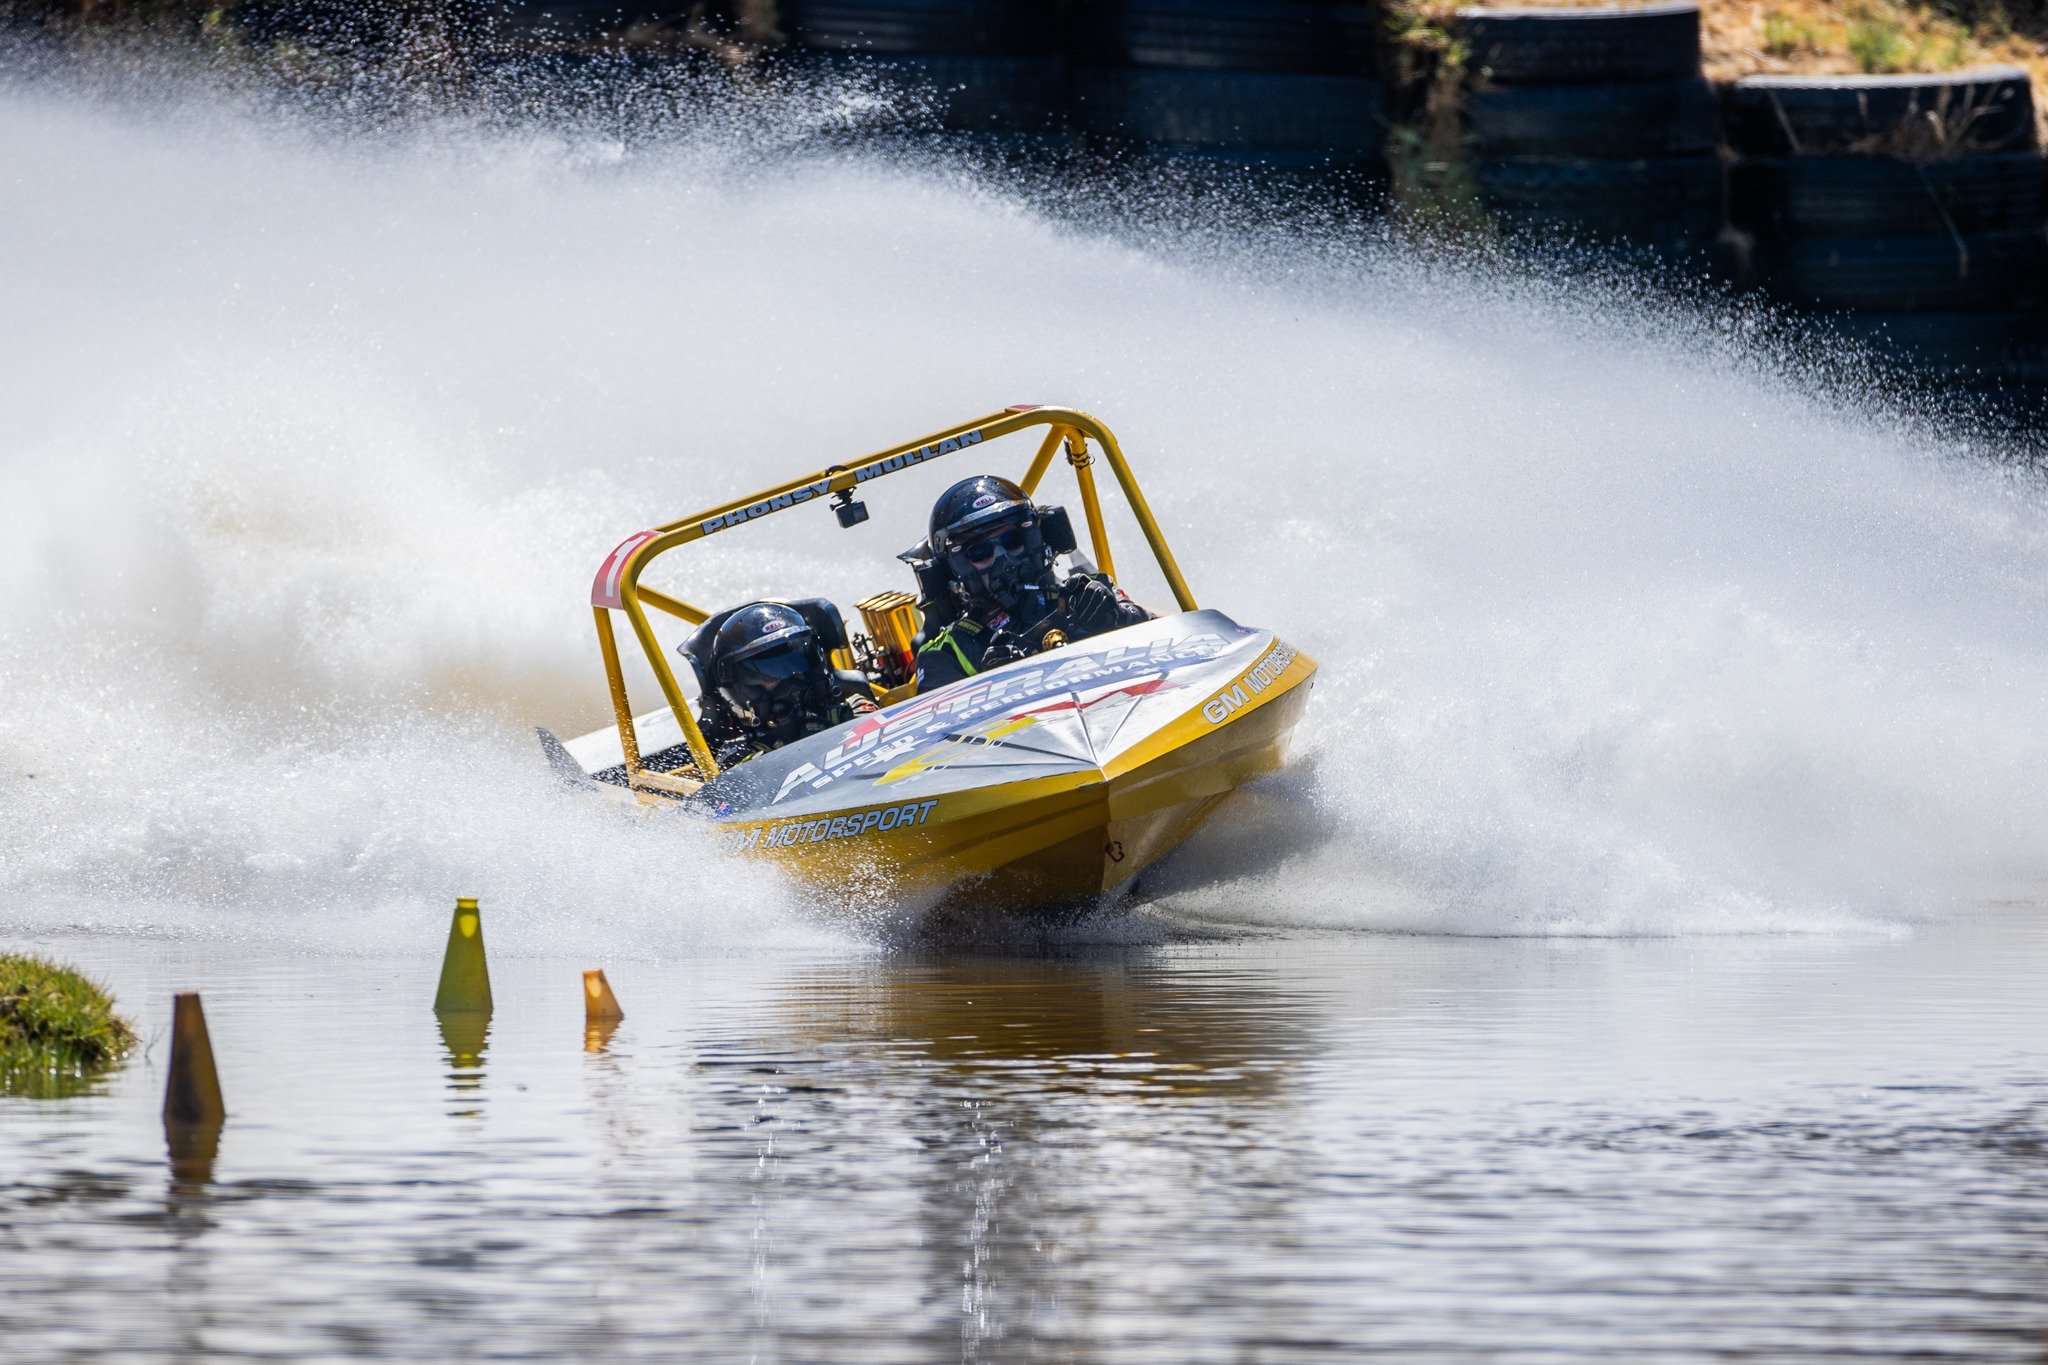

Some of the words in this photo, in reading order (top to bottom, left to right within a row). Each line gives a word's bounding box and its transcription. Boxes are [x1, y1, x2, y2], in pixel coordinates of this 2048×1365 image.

[701, 478, 832, 536] PHONSY
[854, 429, 984, 483] MULLAN
[975, 496, 993, 507] BELL
[765, 621, 783, 632] BELL
[771, 633, 1231, 806] AUSTRALIA
[811, 734, 915, 790] SPEED
[925, 721, 951, 735] &
[958, 645, 1217, 720] PERFORMANCE
[1202, 683, 1251, 724] GM
[763, 799, 939, 850] MOTORSPORT
